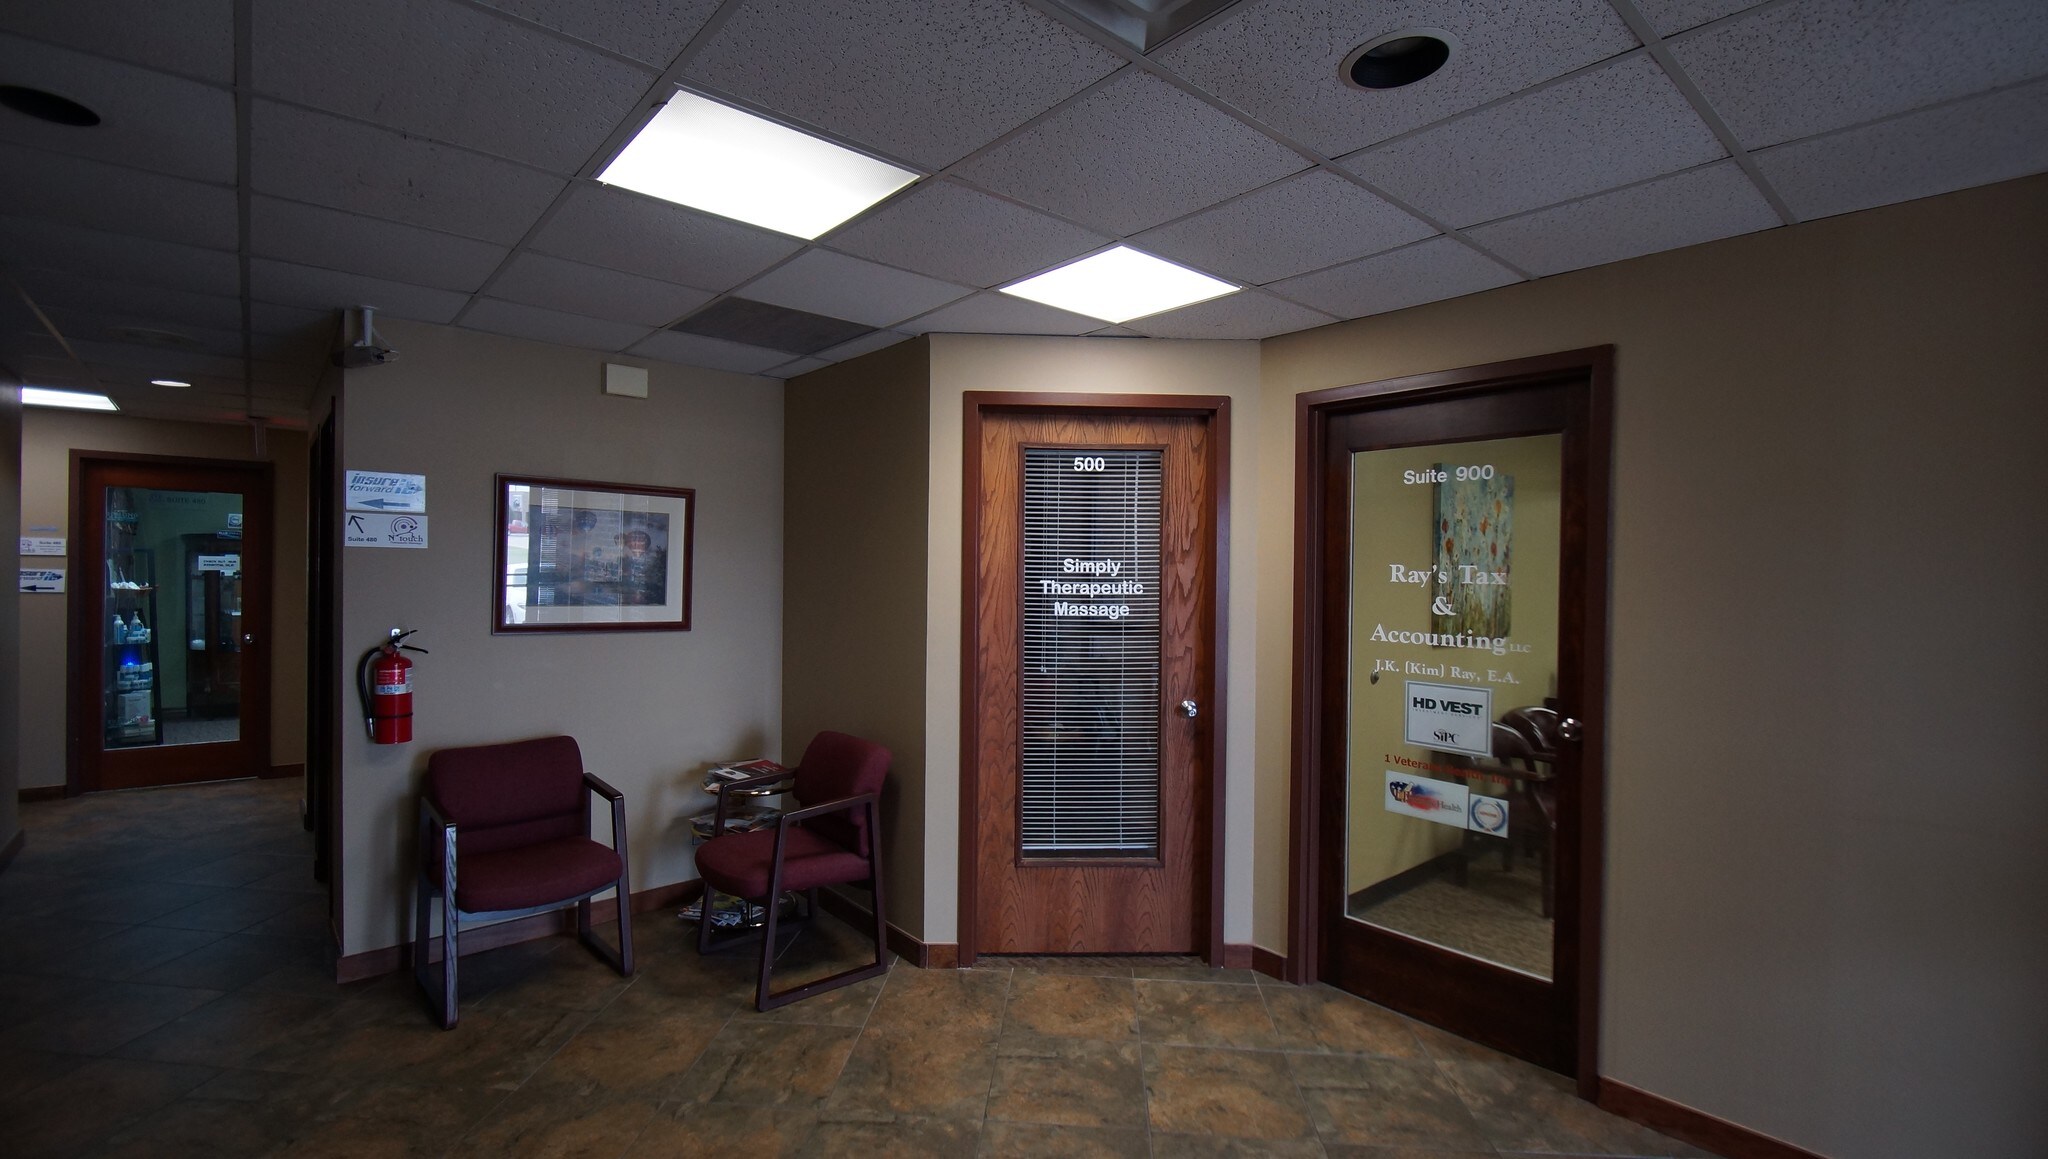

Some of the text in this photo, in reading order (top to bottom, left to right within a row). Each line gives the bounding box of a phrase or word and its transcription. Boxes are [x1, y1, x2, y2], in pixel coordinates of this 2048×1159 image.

[1073, 457, 1105, 472] 500
[351, 473, 399, 486] insure
[1403, 464, 1494, 485] Suite 900
[349, 485, 394, 493] forward
[1063, 558, 1121, 577] Simply
[1389, 564, 1506, 588] Ray's Tax
[1040, 579, 1144, 598] Therapeutic
[1054, 602, 1130, 620] Massage
[1432, 596, 1457, 616] &
[1369, 623, 1532, 656] Accounting LLC
[1374, 659, 1400, 673] J.K.
[1451, 666, 1481, 683] Ray,
[1487, 669, 1520, 685] E.A.
[1412, 697, 1483, 716] HD VEST
[1384, 754, 1391, 764] 1
